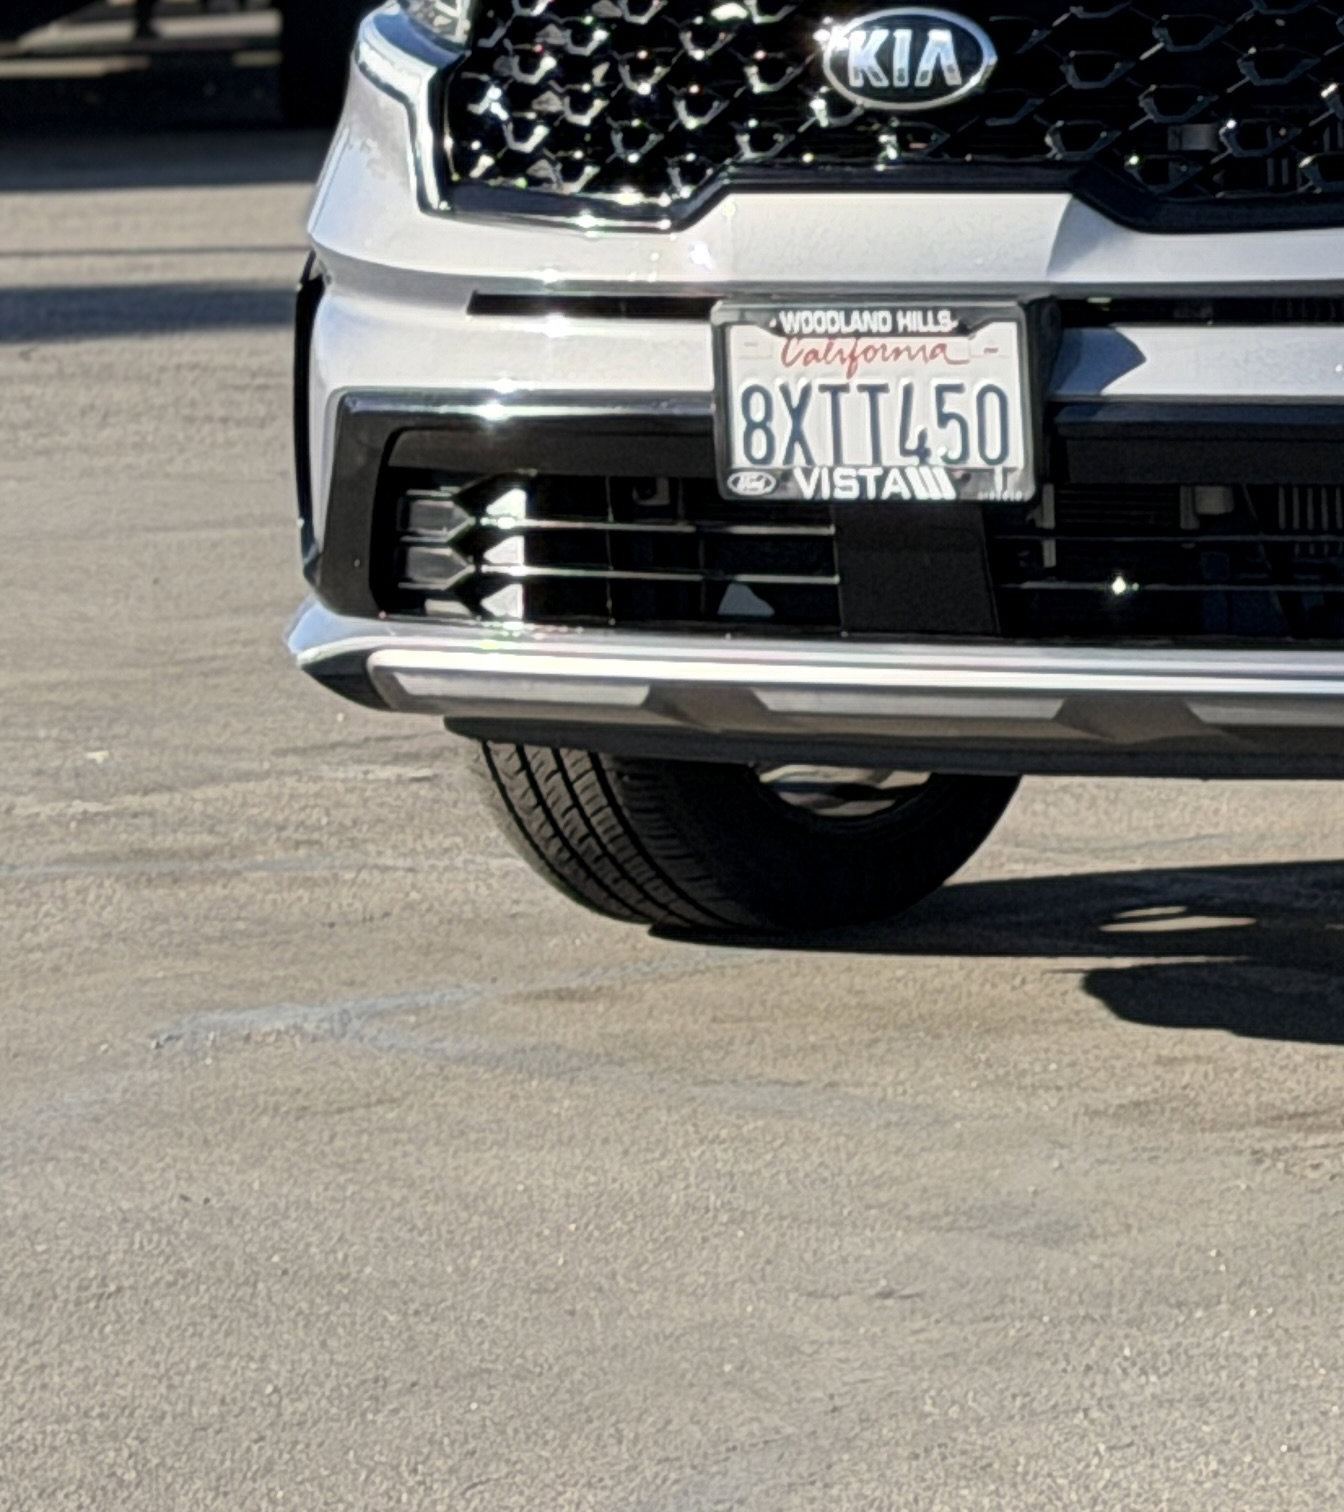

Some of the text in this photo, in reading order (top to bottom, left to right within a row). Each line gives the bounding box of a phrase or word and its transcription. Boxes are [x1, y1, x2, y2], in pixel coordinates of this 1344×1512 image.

[848, 28, 962, 88] KIA
[778, 309, 951, 334] WOODLAND HILLS
[780, 336, 970, 379] California
[740, 381, 1009, 467] 8XTT450
[793, 466, 912, 501] VISTA
